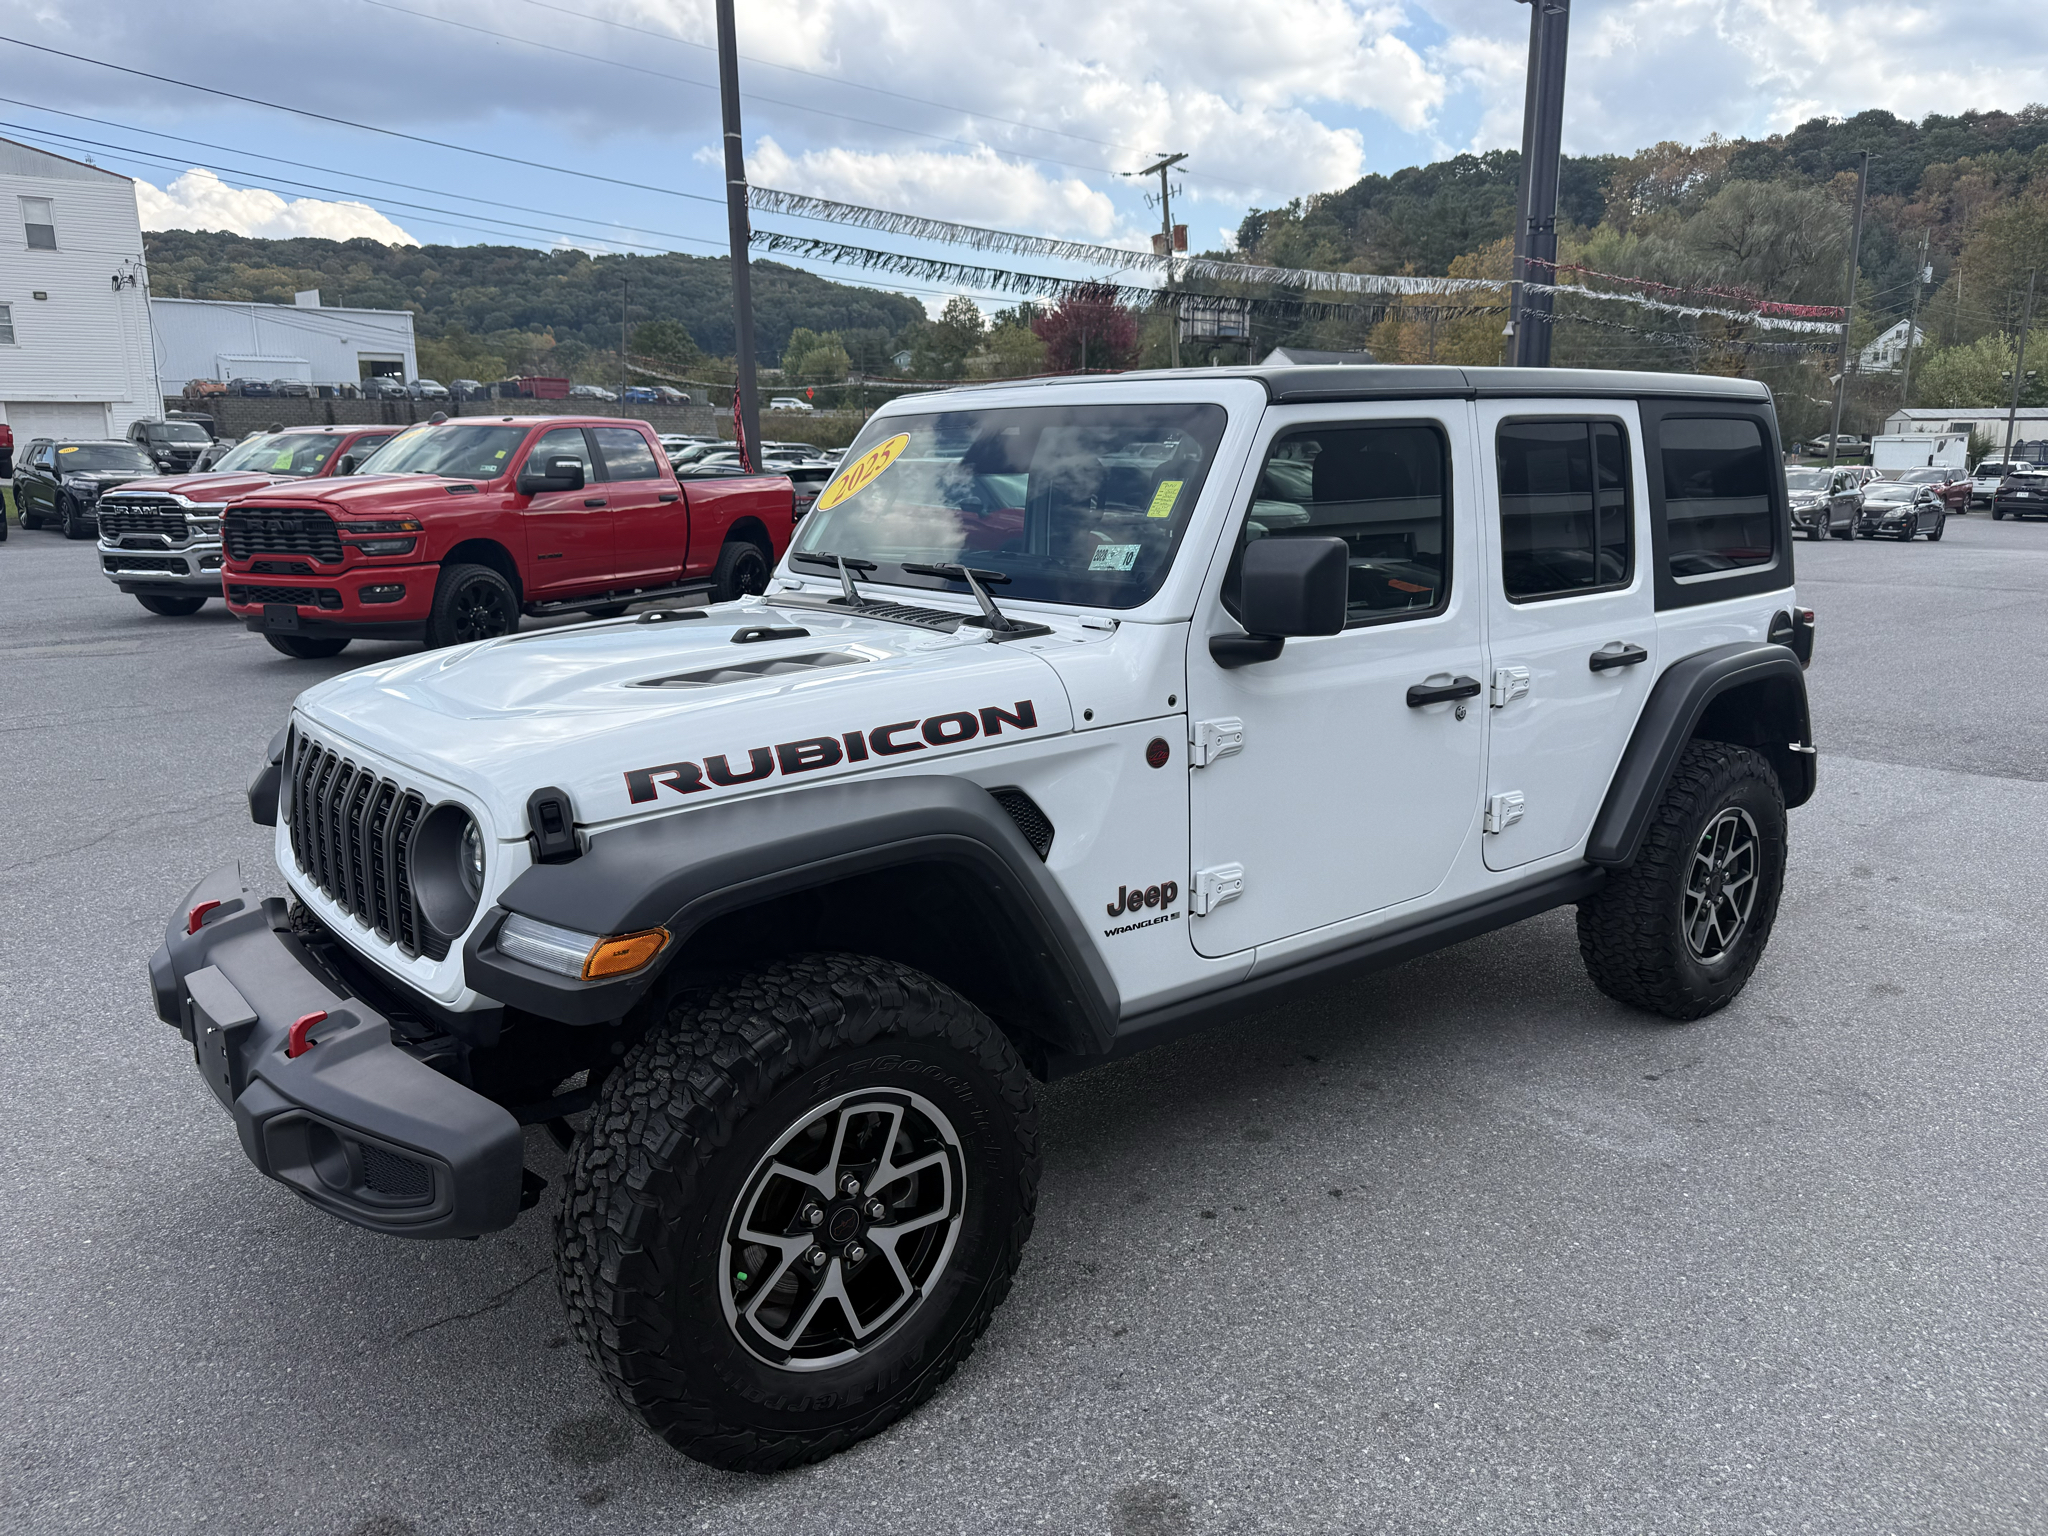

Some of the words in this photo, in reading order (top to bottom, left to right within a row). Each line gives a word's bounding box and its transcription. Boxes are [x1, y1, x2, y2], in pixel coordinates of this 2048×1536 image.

[831, 439, 896, 505] 2025
[116, 505, 158, 516] RAM
[246, 518, 304, 531] RAM
[1122, 551, 1135, 566] 10
[623, 699, 1038, 805] RUBICON
[1106, 880, 1179, 918] Jeep
[1103, 914, 1170, 938] WRANGLER
